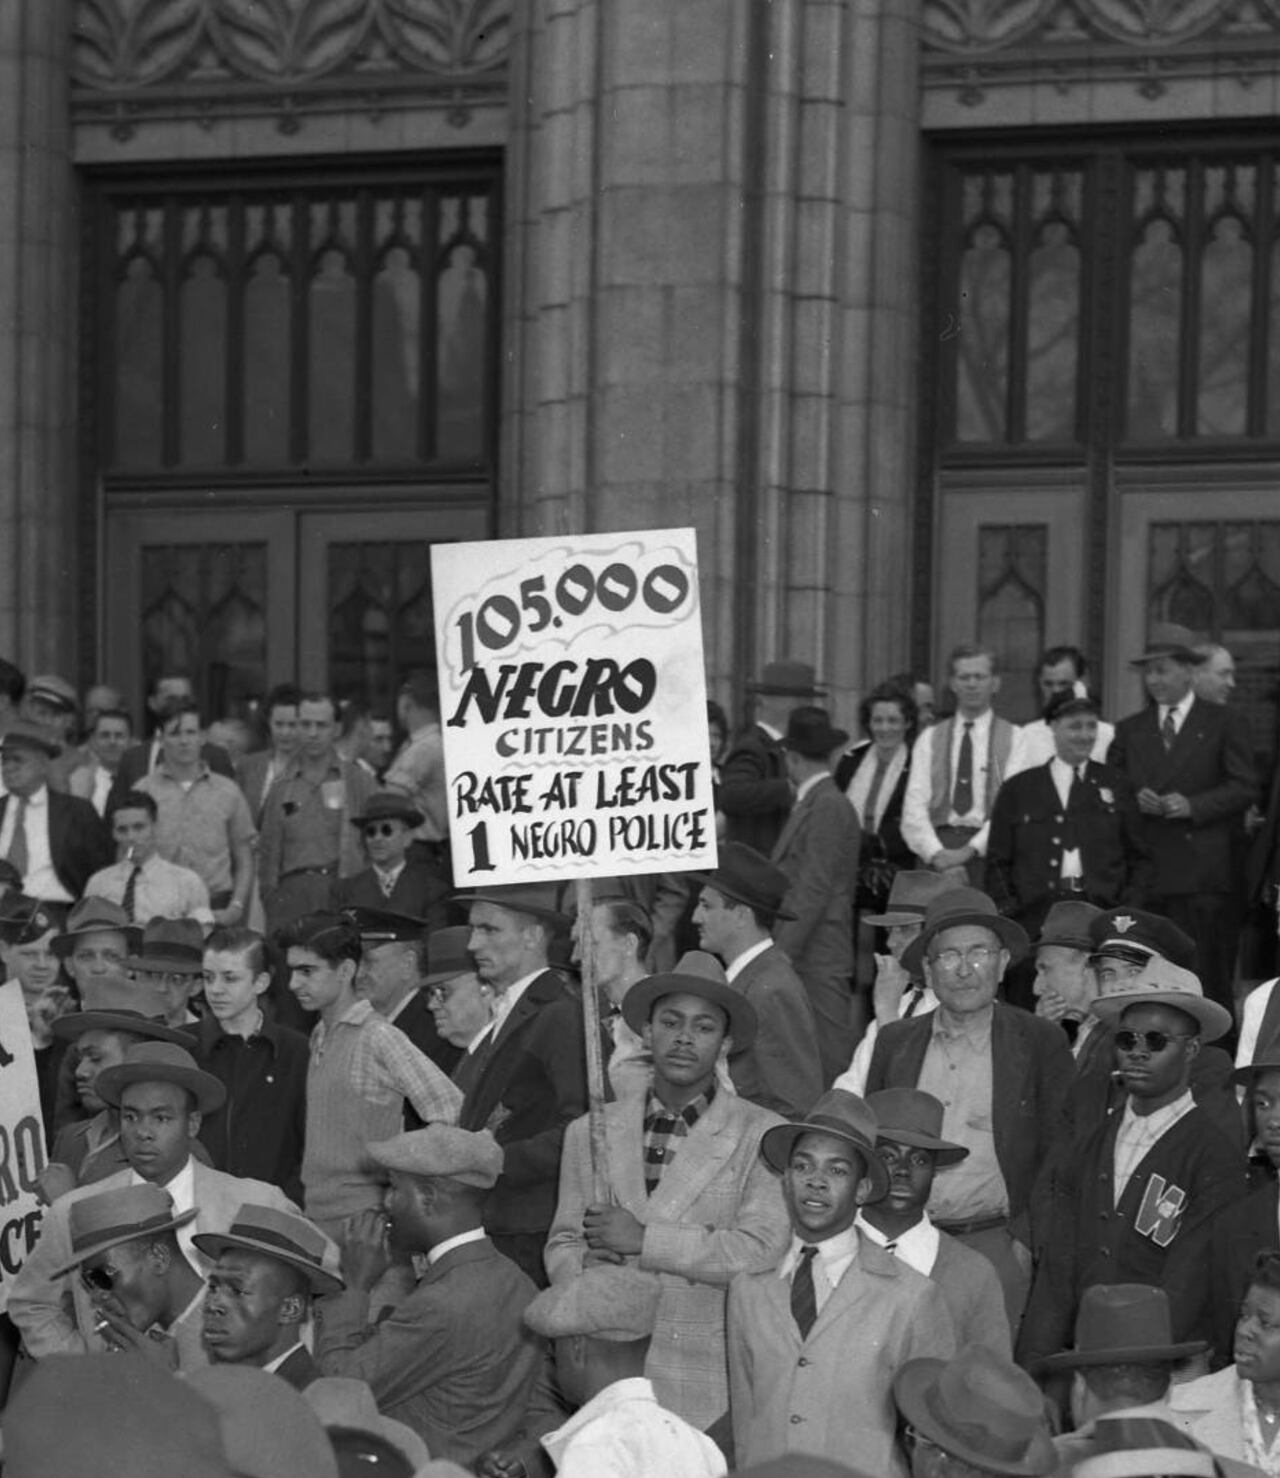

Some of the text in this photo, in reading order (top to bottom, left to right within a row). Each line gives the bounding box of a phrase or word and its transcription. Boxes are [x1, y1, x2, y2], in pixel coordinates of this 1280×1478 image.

[447, 658, 656, 728] NEGRO
[496, 720, 655, 757] CITIZENS
[452, 762, 701, 818] RATE AT LEAST
[467, 808, 709, 874] 1 NEGRO POLICE
